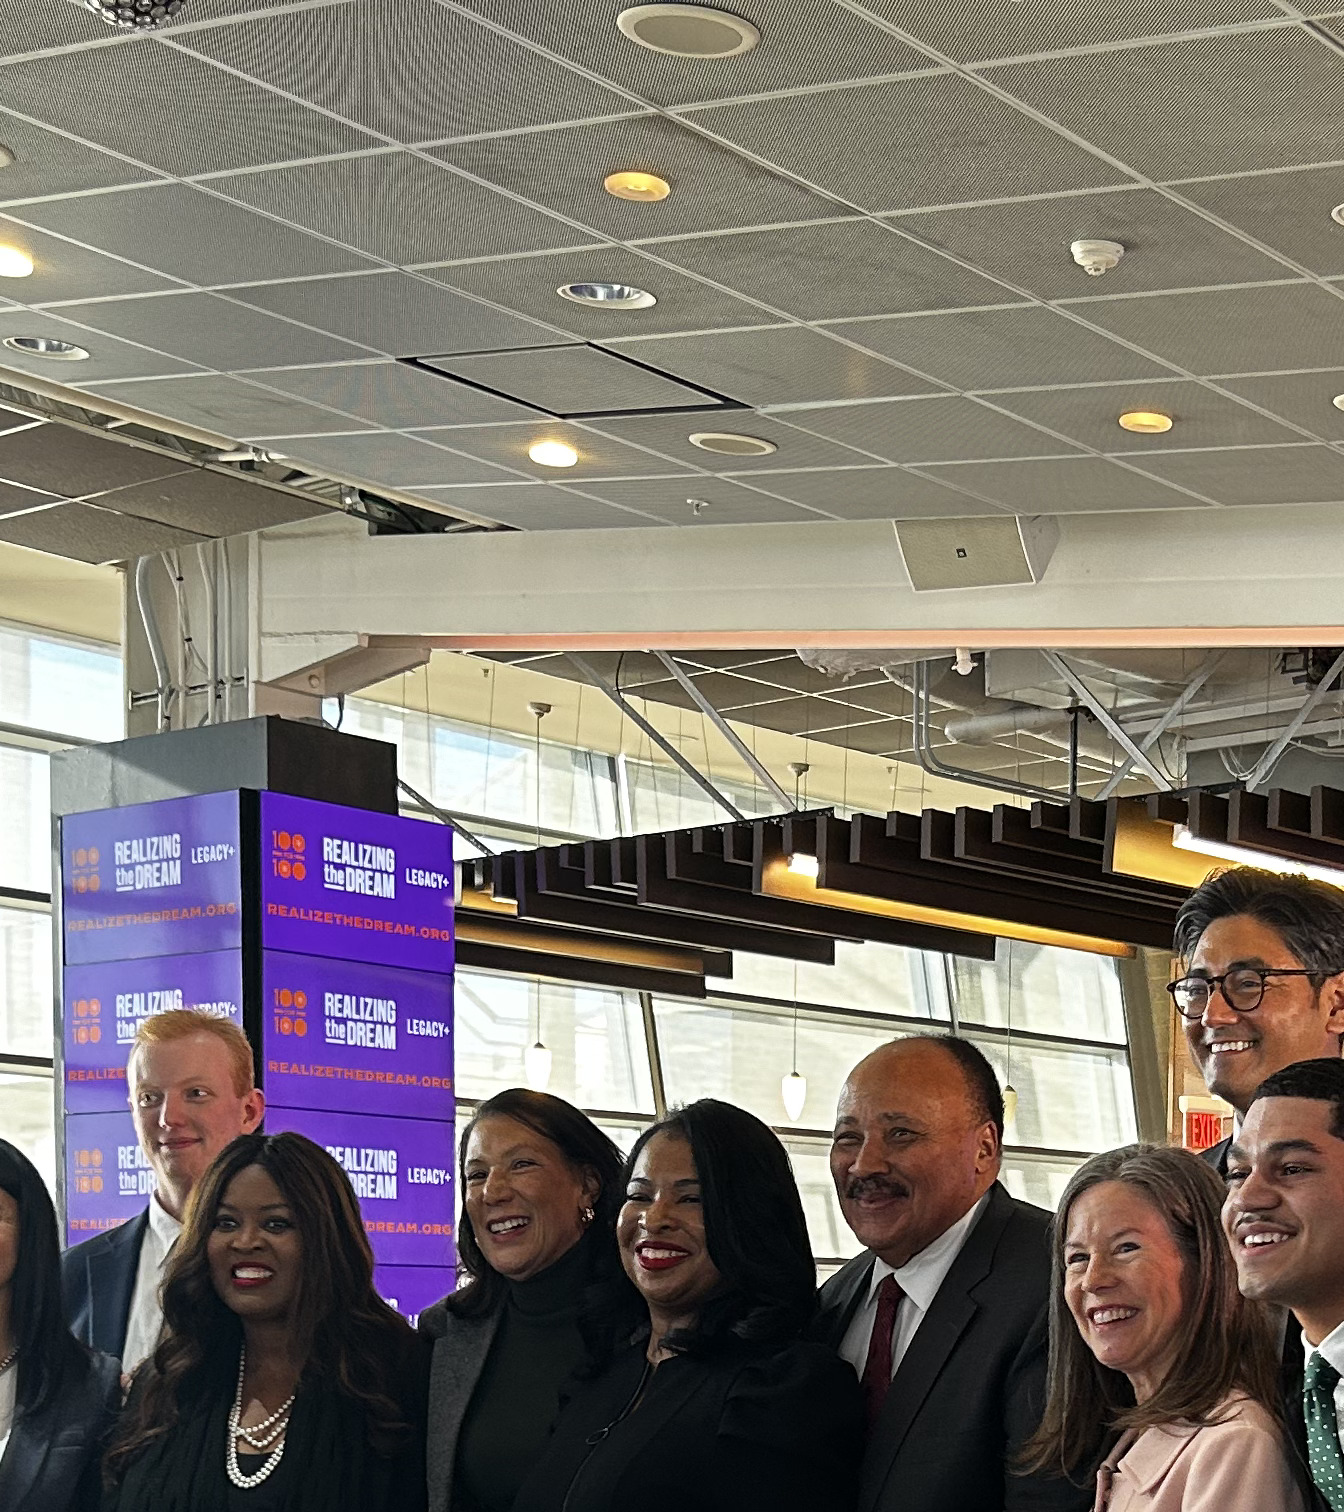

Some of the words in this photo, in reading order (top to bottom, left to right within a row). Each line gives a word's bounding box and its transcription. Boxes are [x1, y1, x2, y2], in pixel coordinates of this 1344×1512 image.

[114, 833, 181, 866] REALIZING
[191, 843, 236, 864] LEGACY+
[323, 836, 396, 873] REALIZING
[135, 860, 182, 890] DREAM
[345, 868, 396, 900] DREAM
[406, 867, 449, 890] LEGACY+
[68, 903, 237, 931] REALIZETHEDREAM.ORG
[267, 903, 451, 942] REALIZETHEDREAM.ORG
[116, 989, 183, 1018] REALIZING
[324, 992, 397, 1024] REALIZING
[346, 1021, 397, 1050] DREAM
[407, 1019, 451, 1038] LEGACY+
[268, 1060, 452, 1089] REALIZETHEDREAM.ORG
[1192, 1113, 1217, 1148] EXIT
[408, 1168, 452, 1185] LEGACY+
